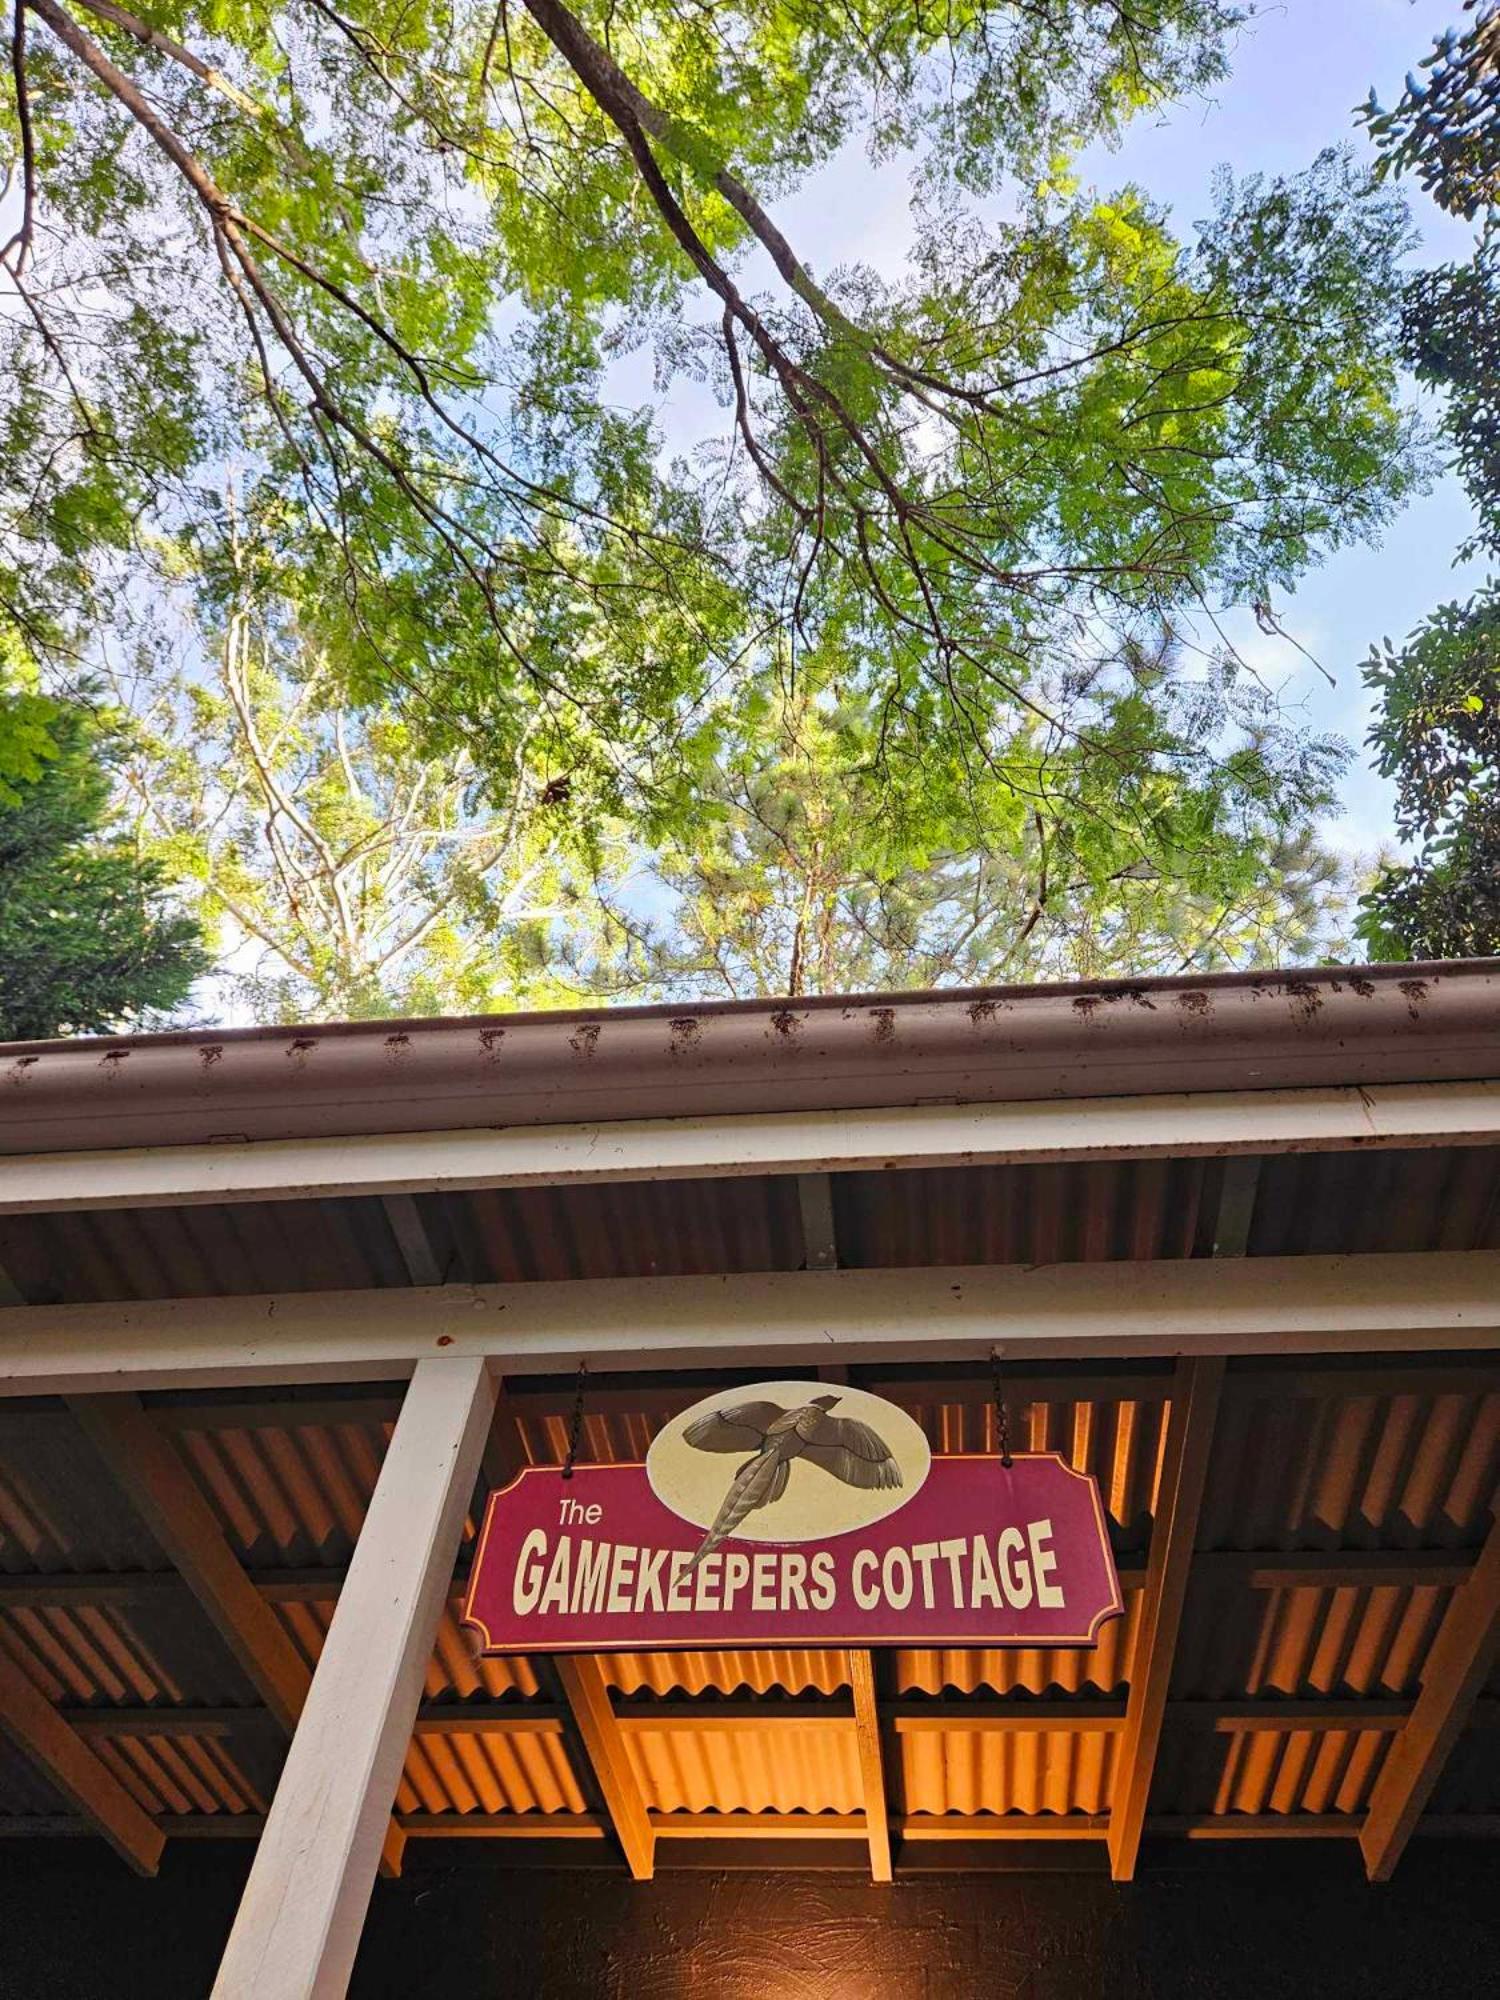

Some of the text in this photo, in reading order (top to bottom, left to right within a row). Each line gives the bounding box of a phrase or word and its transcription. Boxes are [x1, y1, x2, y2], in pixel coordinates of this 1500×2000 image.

[558, 1499, 602, 1525] The
[513, 1519, 1065, 1616] GAMEKEEPERS COTTAGE
